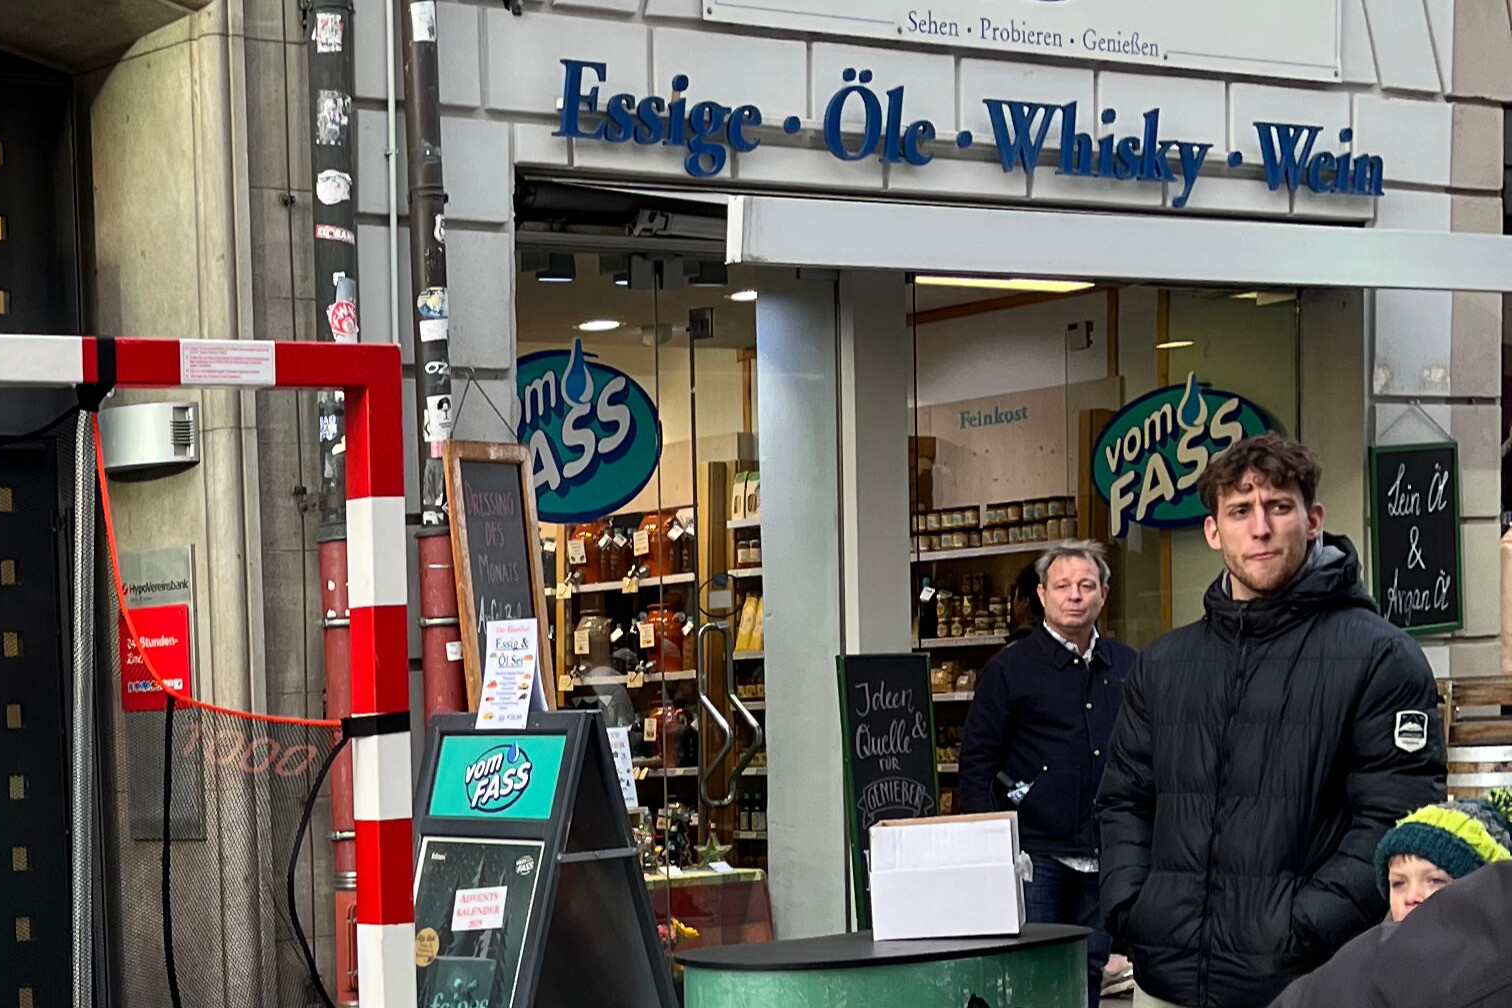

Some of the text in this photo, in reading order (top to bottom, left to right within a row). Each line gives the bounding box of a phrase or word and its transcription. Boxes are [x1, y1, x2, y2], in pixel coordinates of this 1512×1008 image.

[908, 10, 1160, 57] Sehen Probieren Genießen
[551, 58, 1385, 208] Essige Öle Whisky Wein
[530, 376, 631, 491] ASS
[960, 405, 1027, 429] Feinkost
[1106, 403, 1173, 473] vom
[1110, 398, 1243, 537] FASS
[1408, 526, 1425, 569] &
[855, 681, 915, 717] Ideen
[855, 719, 912, 759] Quelle
[912, 711, 928, 739] &
[184, 721, 318, 777] 1000
[465, 752, 504, 784] vom
[471, 761, 532, 808] FASS
[457, 904, 499, 917] KALENDER
[461, 892, 498, 904] ADVENTS
